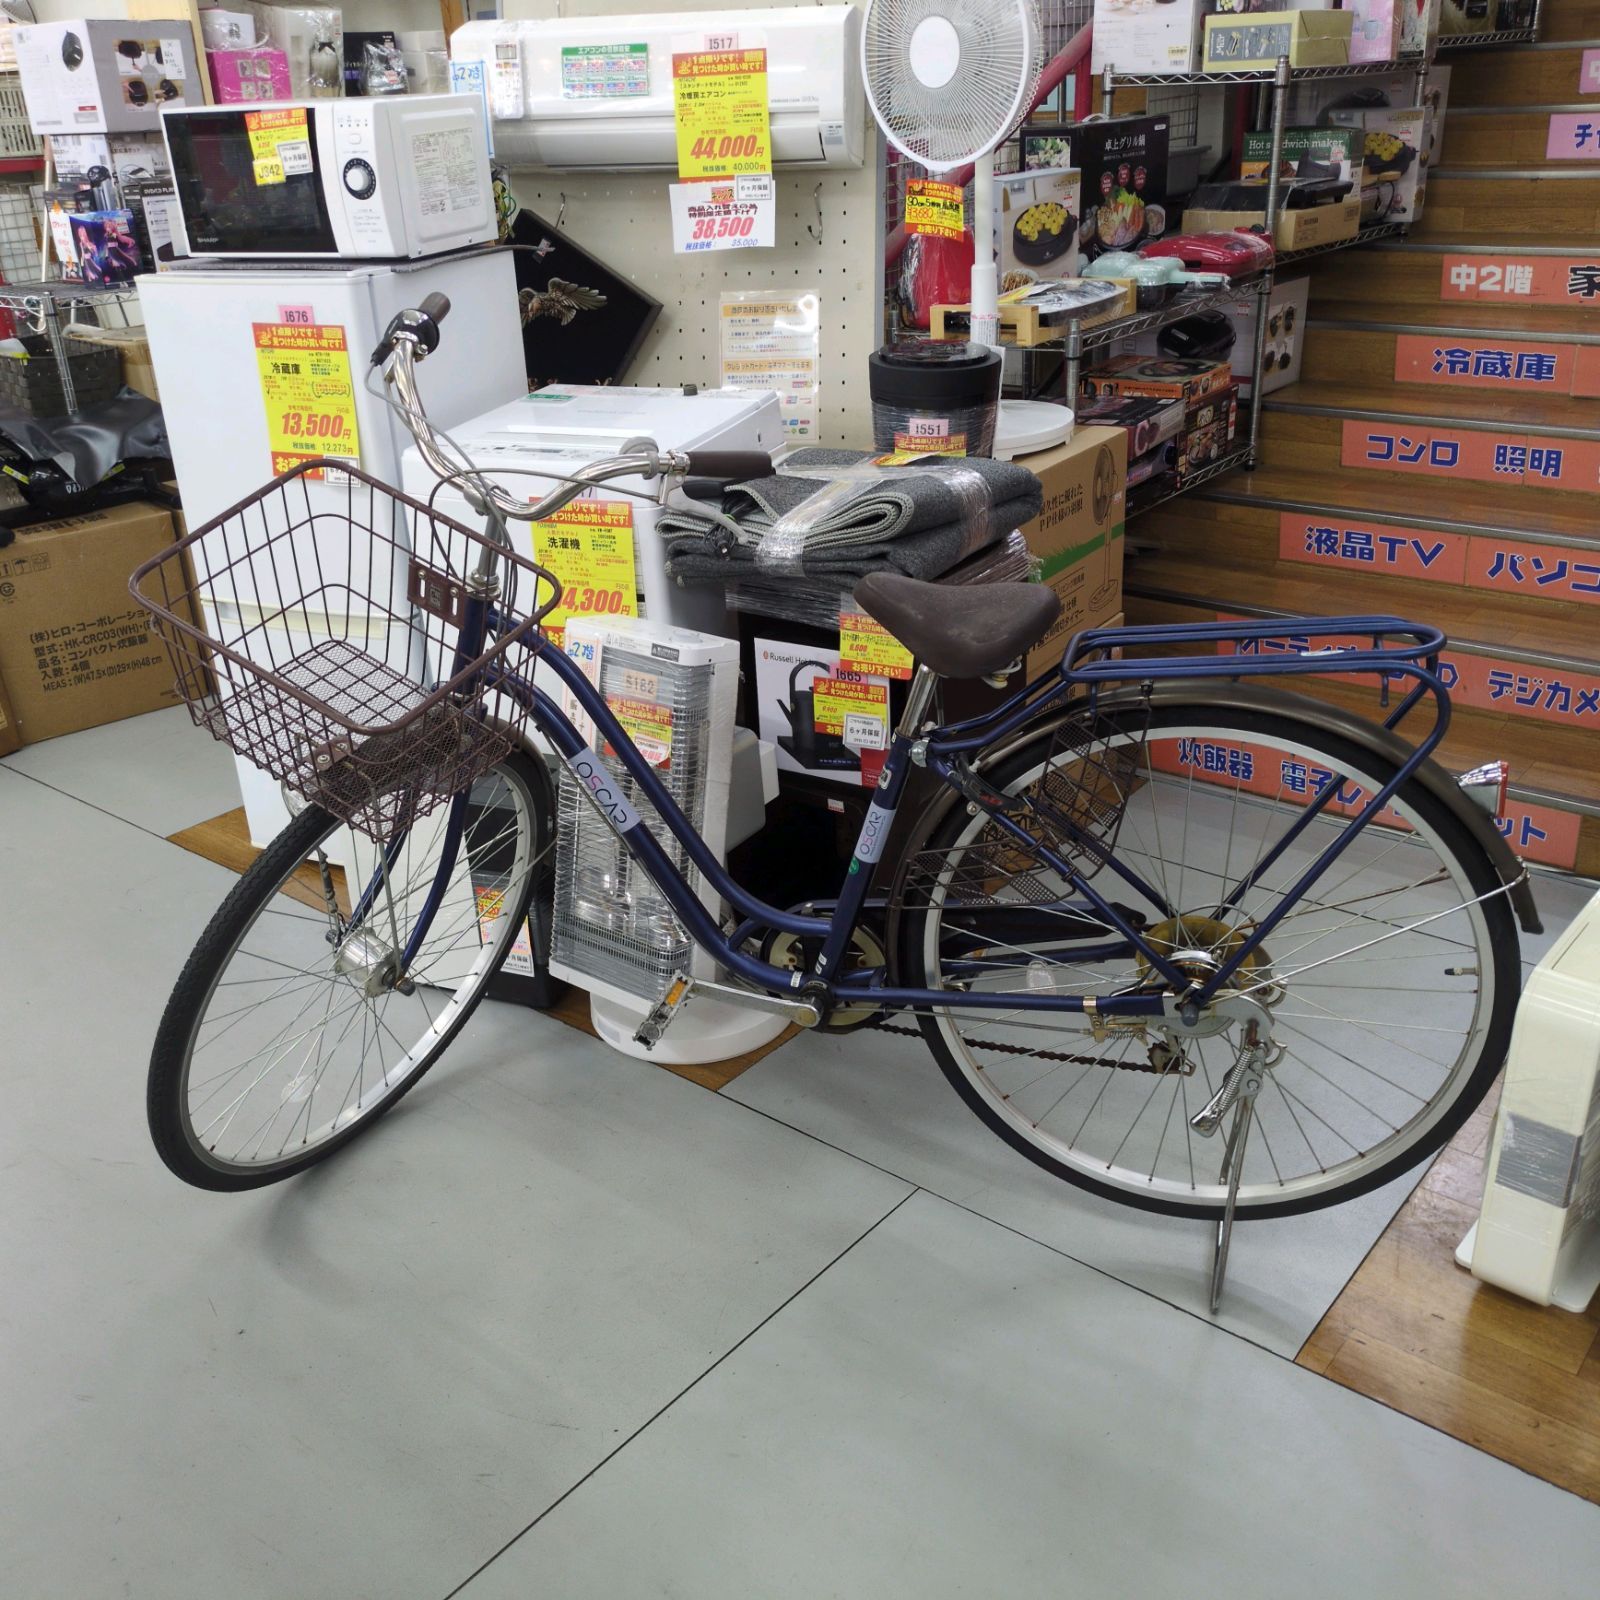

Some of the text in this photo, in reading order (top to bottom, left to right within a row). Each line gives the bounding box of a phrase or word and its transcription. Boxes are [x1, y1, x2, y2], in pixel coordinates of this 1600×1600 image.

[1104, 134, 1147, 151] 卓上グリル鍋
[1249, 138, 1344, 150] Hot sdwich maker
[692, 216, 755, 240] 38,500
[1450, 263, 1533, 295] 中2階
[271, 362, 302, 375] 冷蔵庫
[1431, 347, 1557, 382] 冷蔵庫
[1366, 434, 1564, 479] コンロ 照明
[547, 536, 581, 550] 洗濯機
[1304, 525, 1446, 568] 液晶TV
[769, 652, 794, 664] Russell
[851, 662, 902, 679] お売り下さい!
[1178, 737, 1253, 780] 炊飯器
[576, 761, 628, 825] OSCAR
[860, 811, 882, 855] OSCAR
